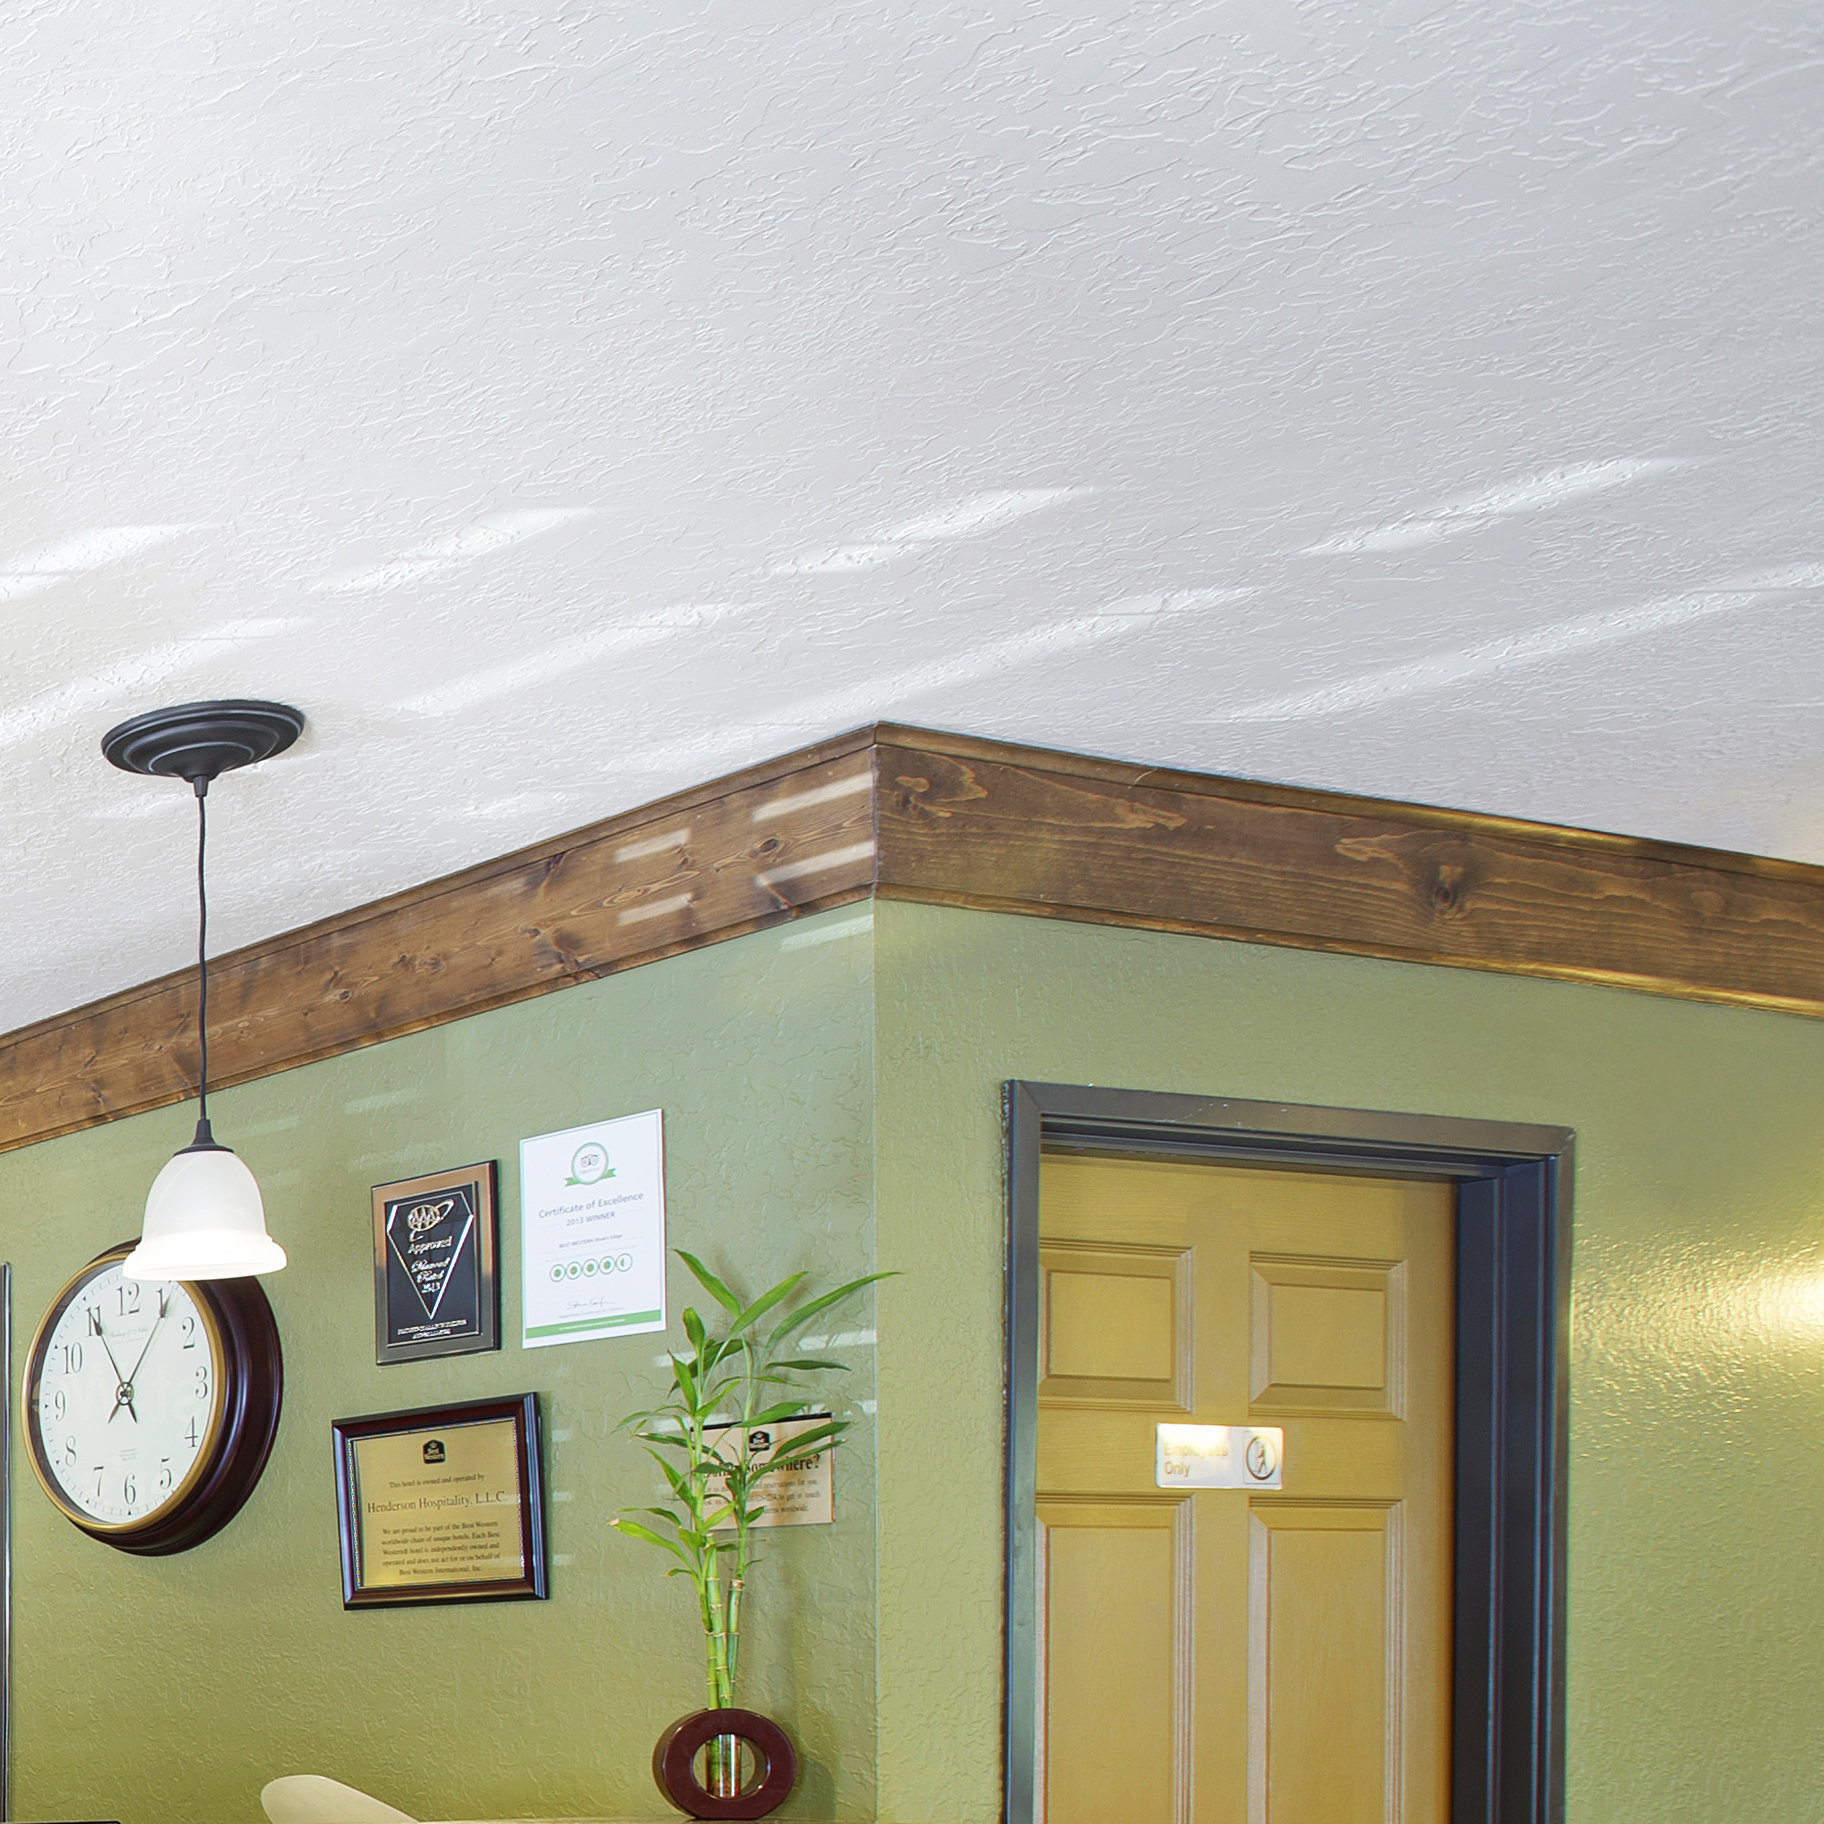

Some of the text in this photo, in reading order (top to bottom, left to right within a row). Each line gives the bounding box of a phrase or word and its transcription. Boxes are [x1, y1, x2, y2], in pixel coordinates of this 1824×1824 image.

[539, 1193, 644, 1218] Certificate of Excellence
[566, 1212, 615, 1226] 2013 WINNER
[408, 1236, 452, 1254] Approved
[117, 1282, 140, 1316] 12
[156, 1287, 167, 1318] 1
[182, 1317, 195, 1349] 2
[62, 1342, 83, 1375] 10
[195, 1366, 208, 1399] 3
[55, 1391, 65, 1420] 9
[184, 1416, 198, 1447] 4
[64, 1436, 77, 1467] 8
[93, 1466, 104, 1497] 7
[159, 1458, 172, 1489] 5
[1164, 1461, 1190, 1477] Only
[124, 1473, 136, 1505] 6
[368, 1502, 416, 1513] Henderson
